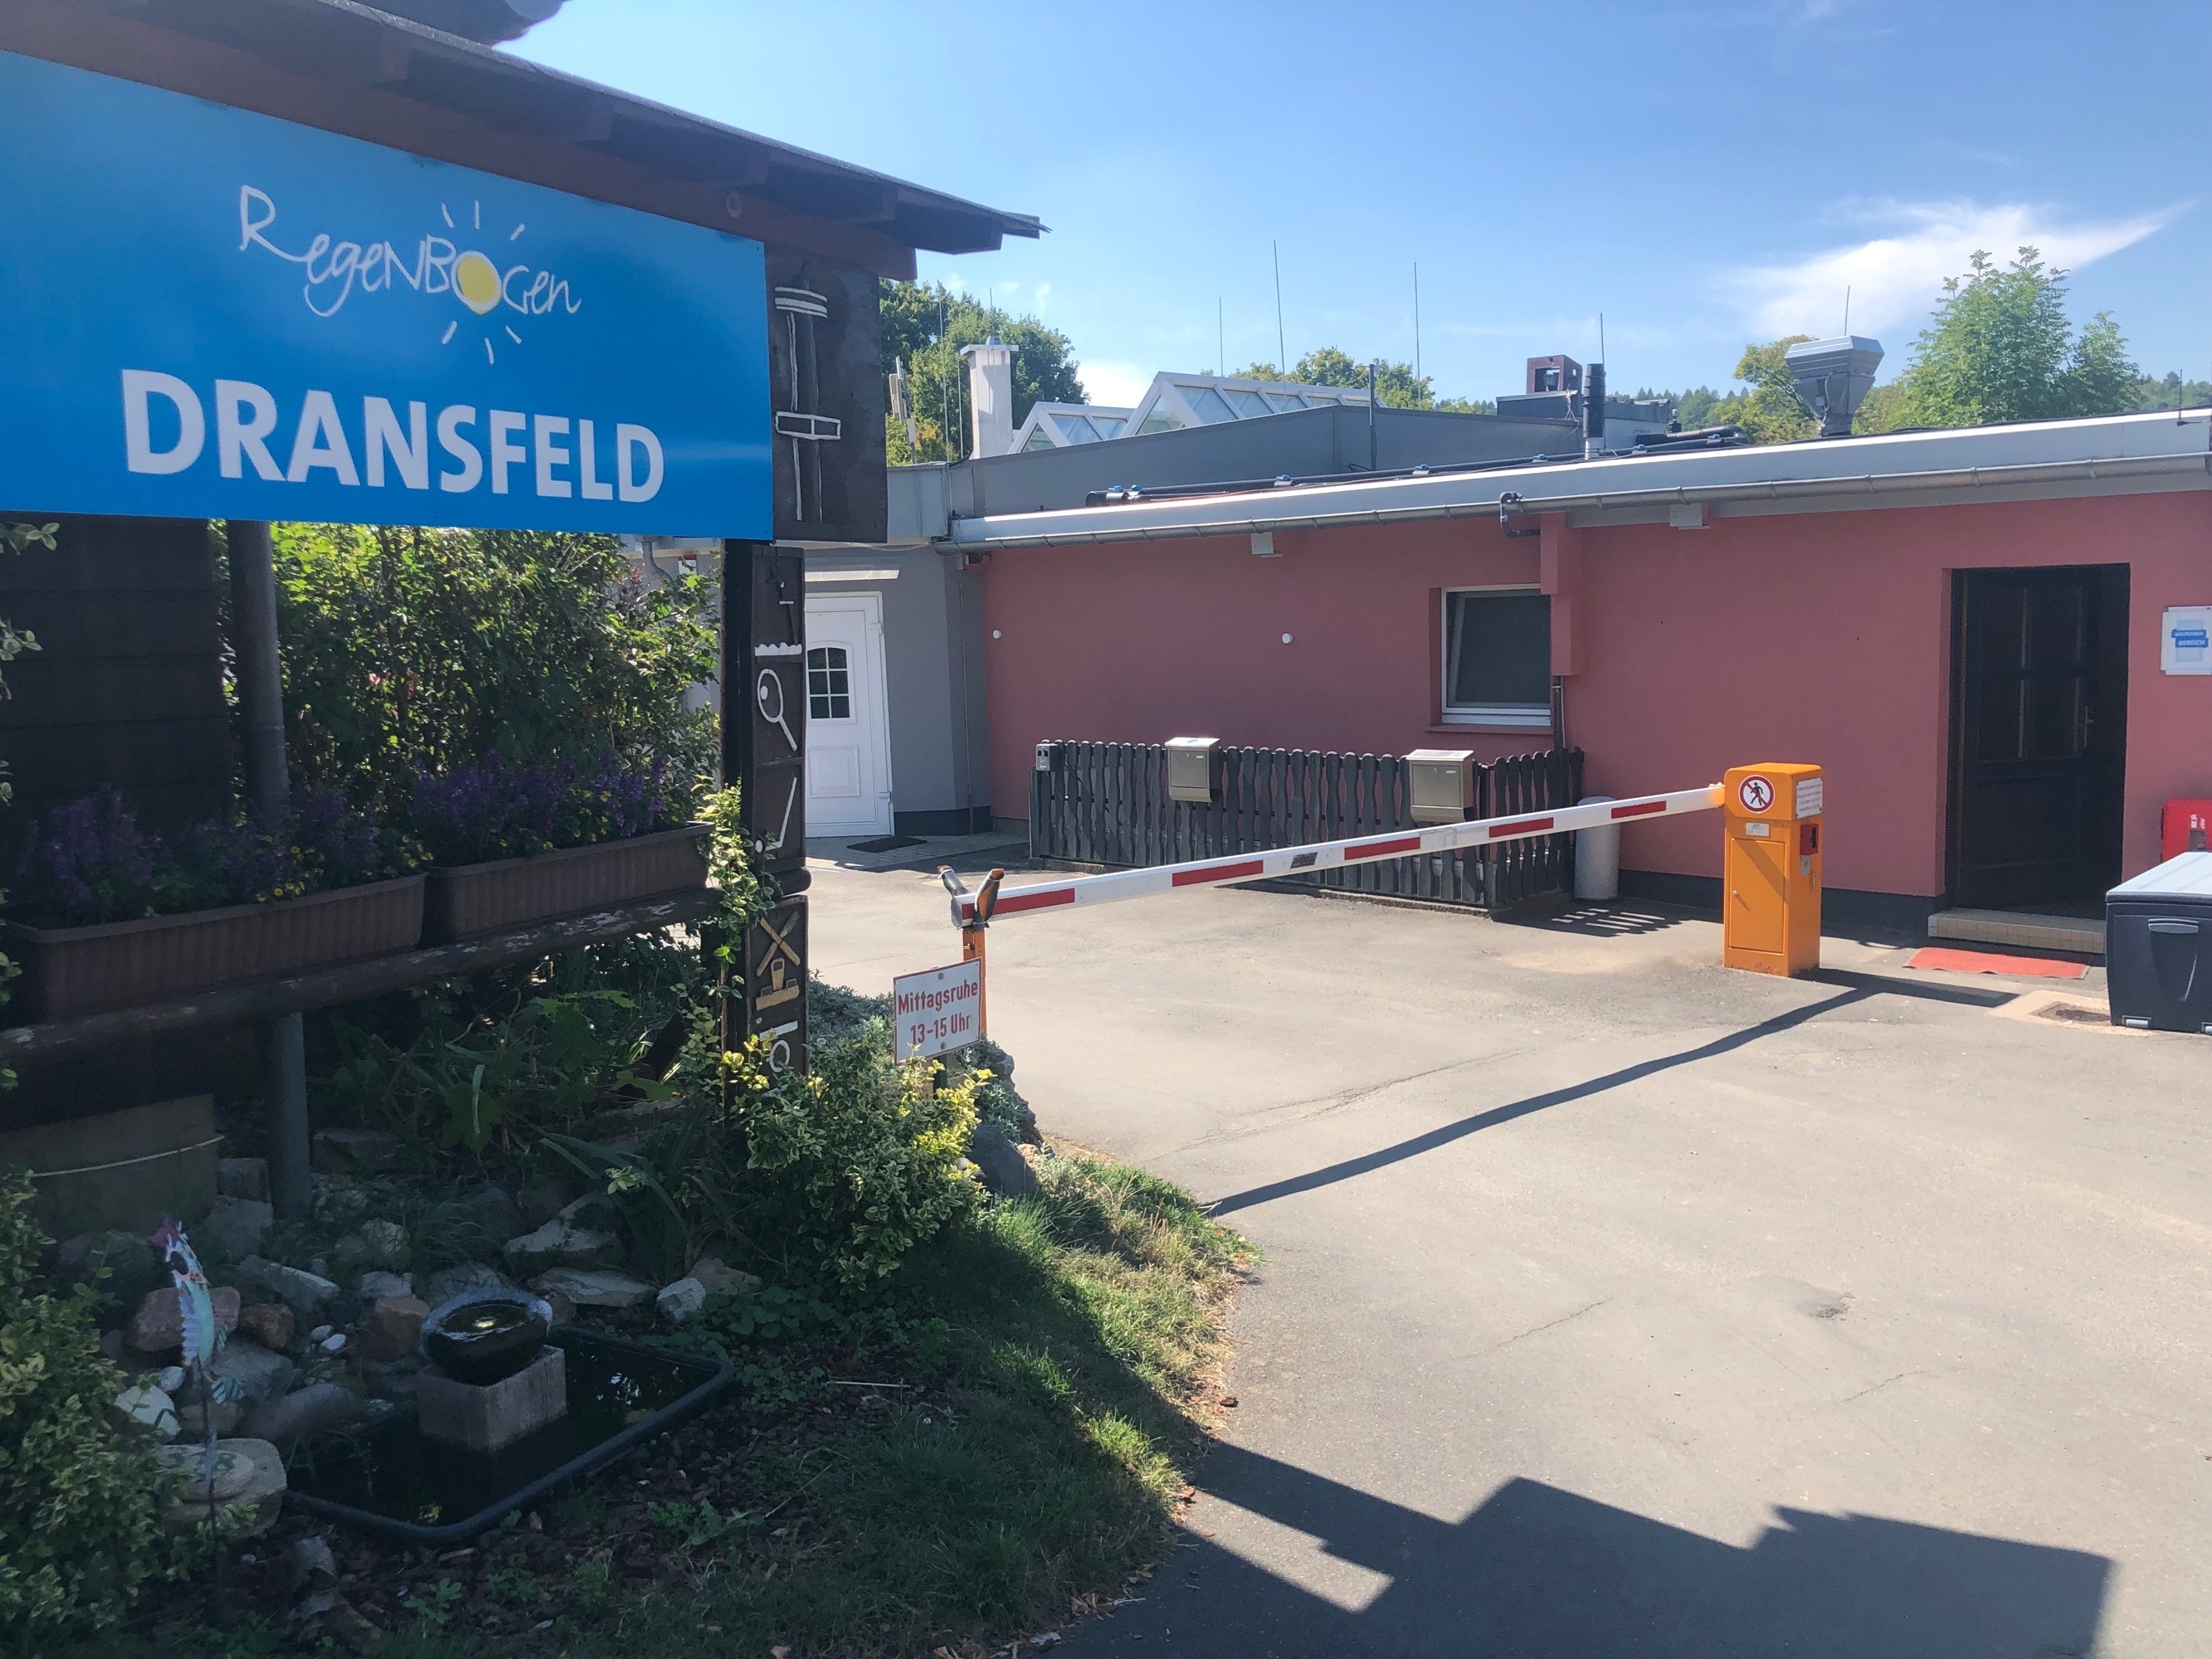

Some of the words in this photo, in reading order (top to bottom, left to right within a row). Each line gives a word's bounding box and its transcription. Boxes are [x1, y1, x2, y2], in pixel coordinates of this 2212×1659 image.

[122, 369, 664, 503] DRANSFELD
[898, 979, 978, 1015] Mittagsruhe
[910, 1017, 948, 1045] 13-15
[951, 1013, 971, 1034] Uhr
